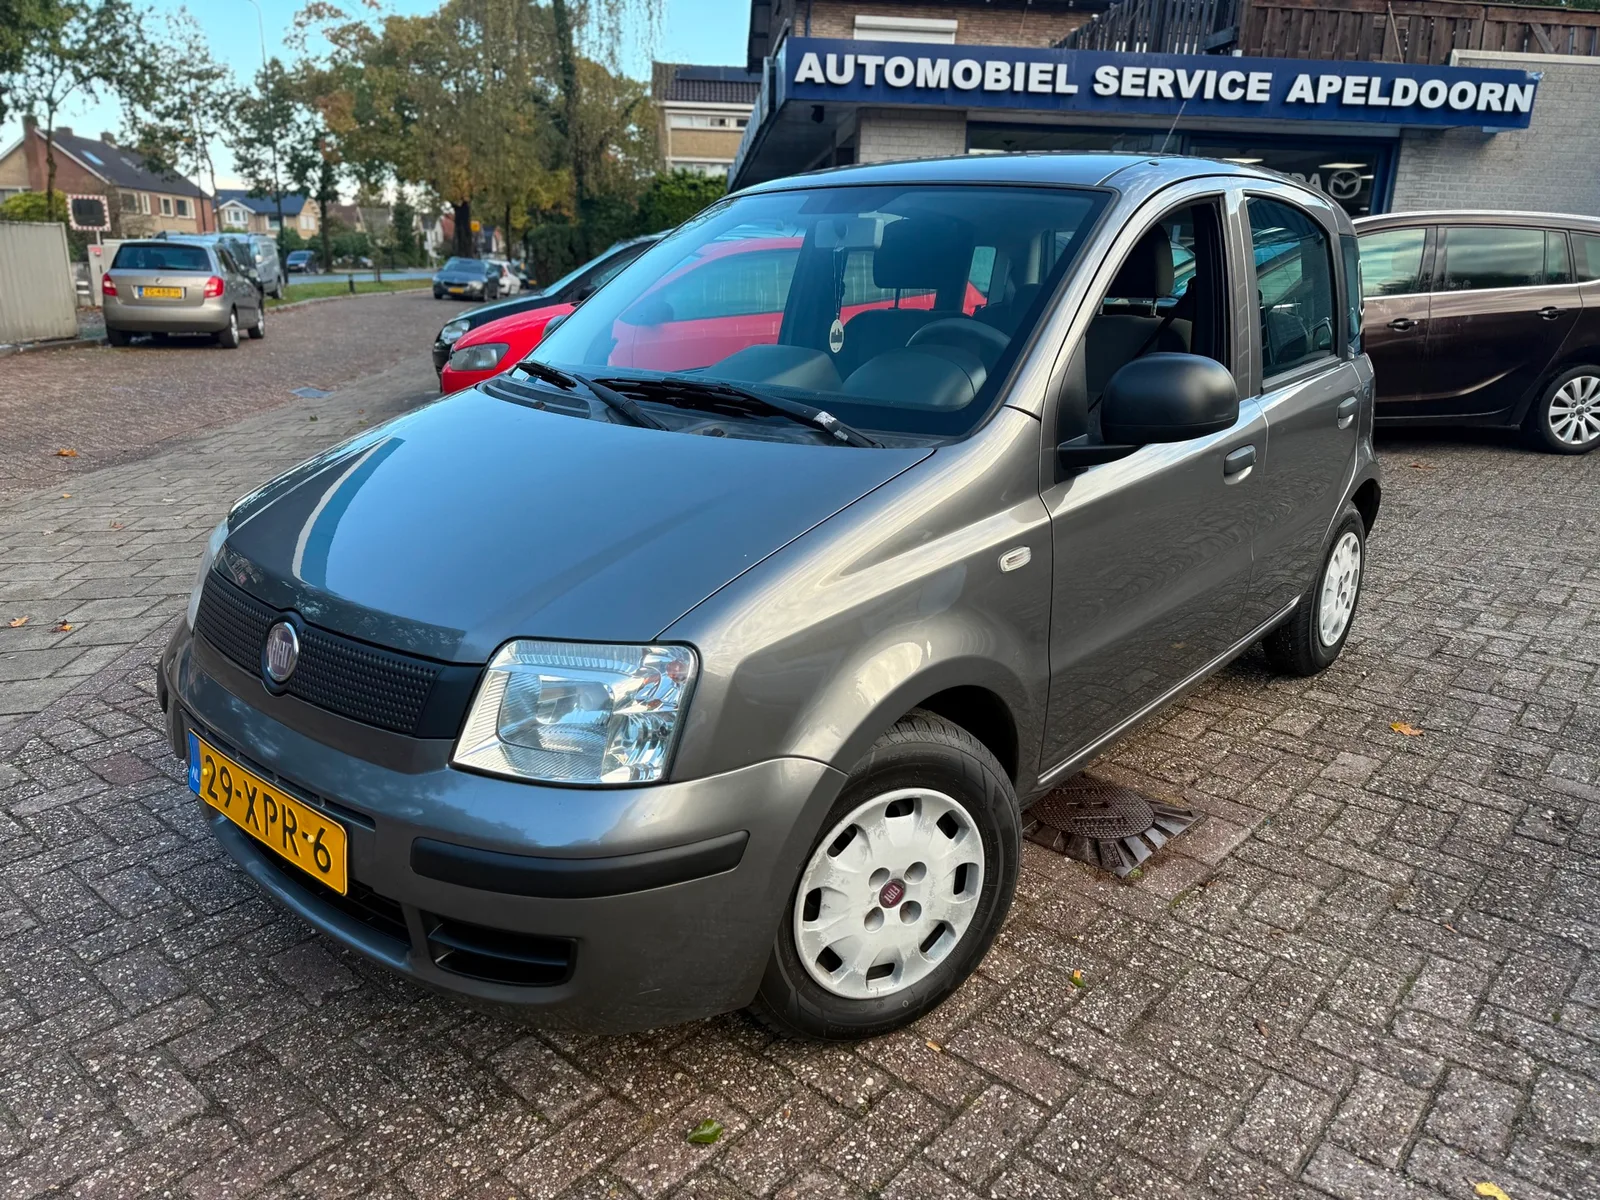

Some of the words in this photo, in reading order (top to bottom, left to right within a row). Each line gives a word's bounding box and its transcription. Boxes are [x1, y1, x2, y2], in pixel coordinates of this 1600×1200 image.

[794, 52, 1079, 94] AUTOMOBIEL
[1093, 65, 1273, 102] SERVICE
[1286, 74, 1535, 113] APELDOORN
[270, 637, 292, 669] FIAT
[205, 754, 333, 873] 29-XPR-6
[883, 885, 901, 904] FIAT
